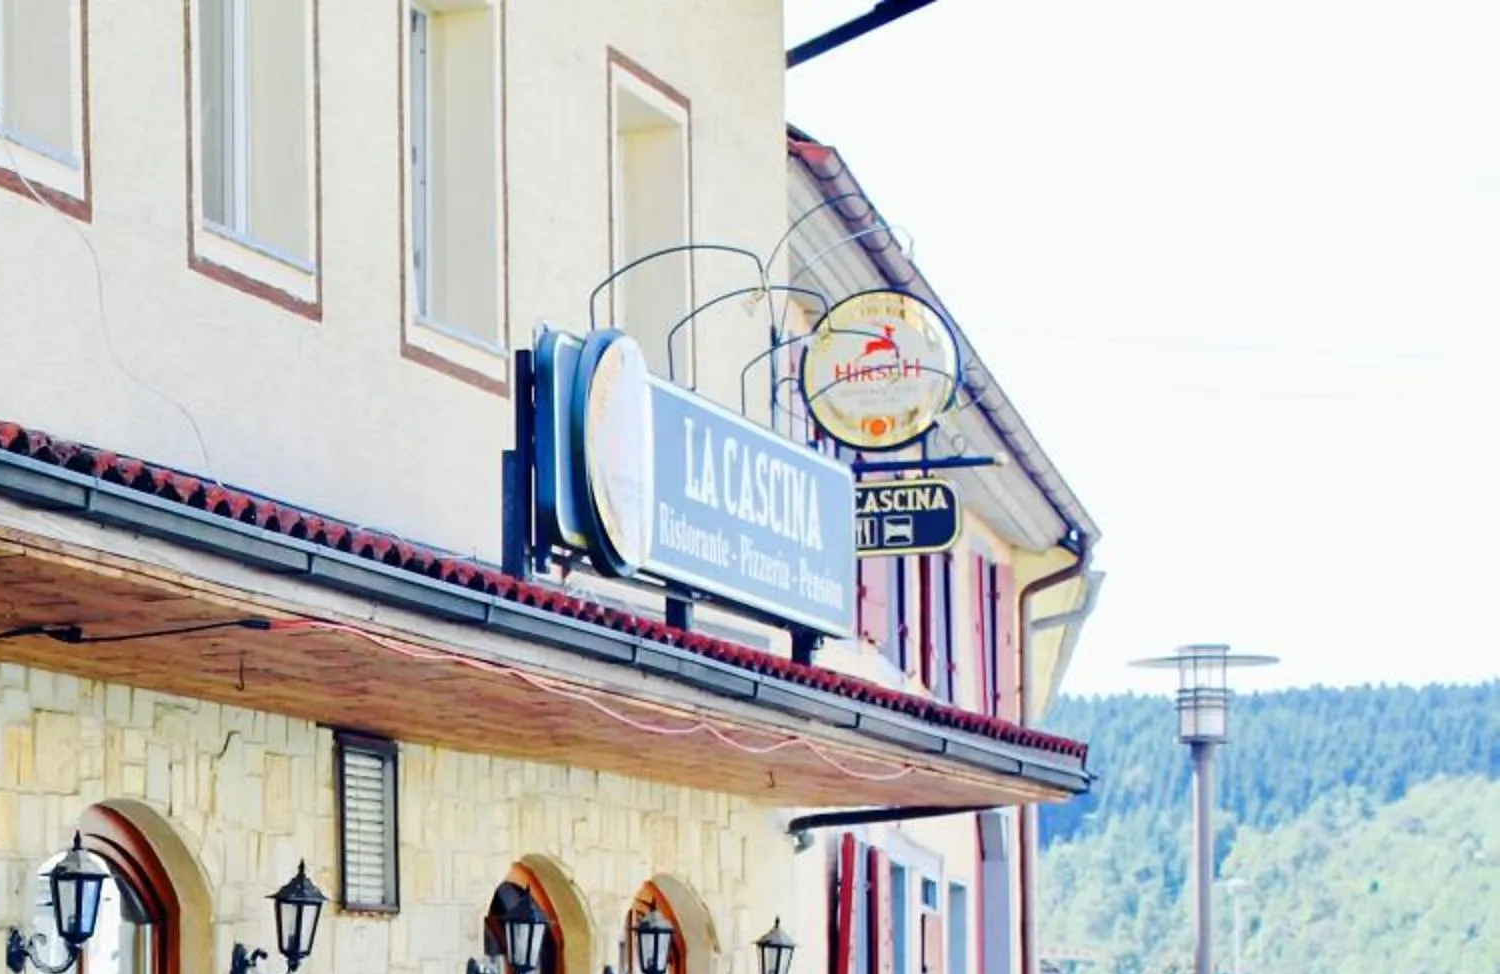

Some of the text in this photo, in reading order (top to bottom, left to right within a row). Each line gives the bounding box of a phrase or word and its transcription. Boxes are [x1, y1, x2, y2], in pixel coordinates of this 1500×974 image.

[684, 416, 823, 551] LA CASCINA
[658, 501, 730, 568] Ristorante
[740, 533, 790, 592] Pizzeria
[799, 556, 843, 611] Pension
